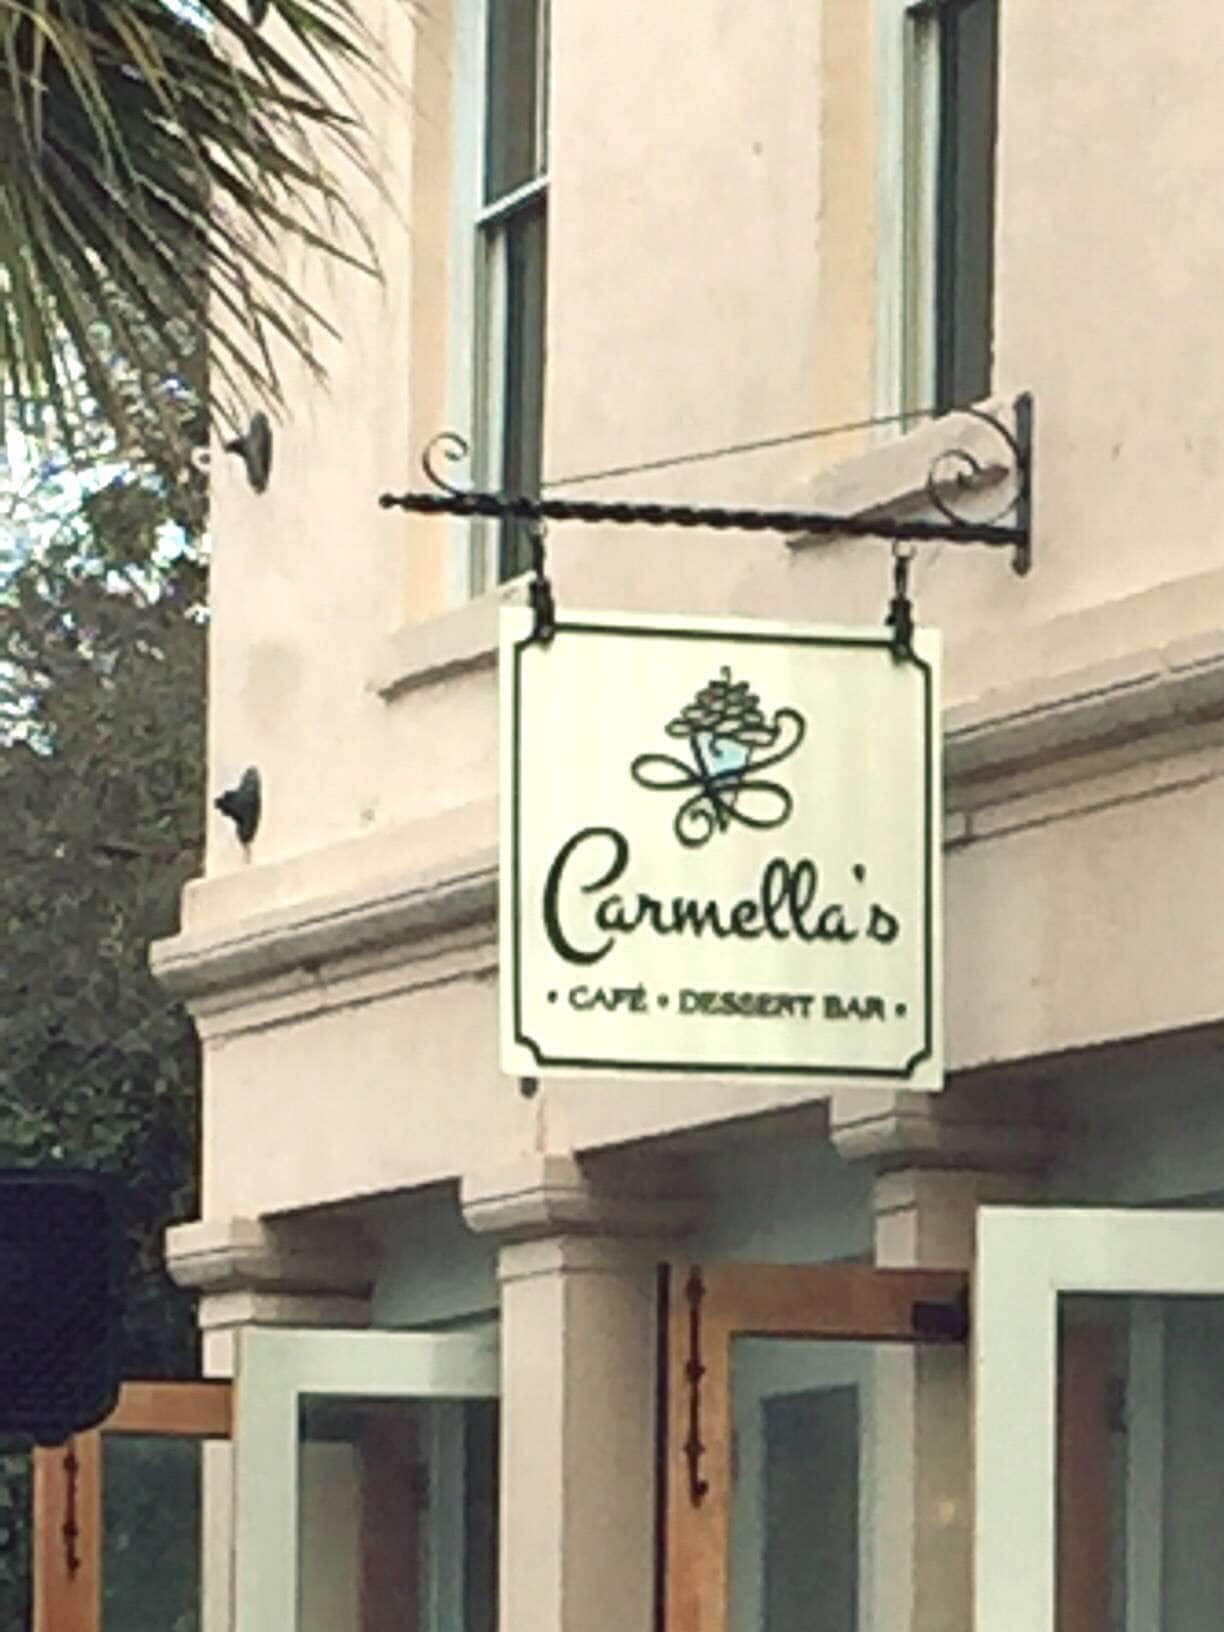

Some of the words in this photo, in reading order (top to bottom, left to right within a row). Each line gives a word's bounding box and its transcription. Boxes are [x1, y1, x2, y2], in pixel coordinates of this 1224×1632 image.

[543, 827, 899, 965] Carmella's
[679, 989, 814, 1020] DESSERT
[825, 994, 885, 1021] BAR
